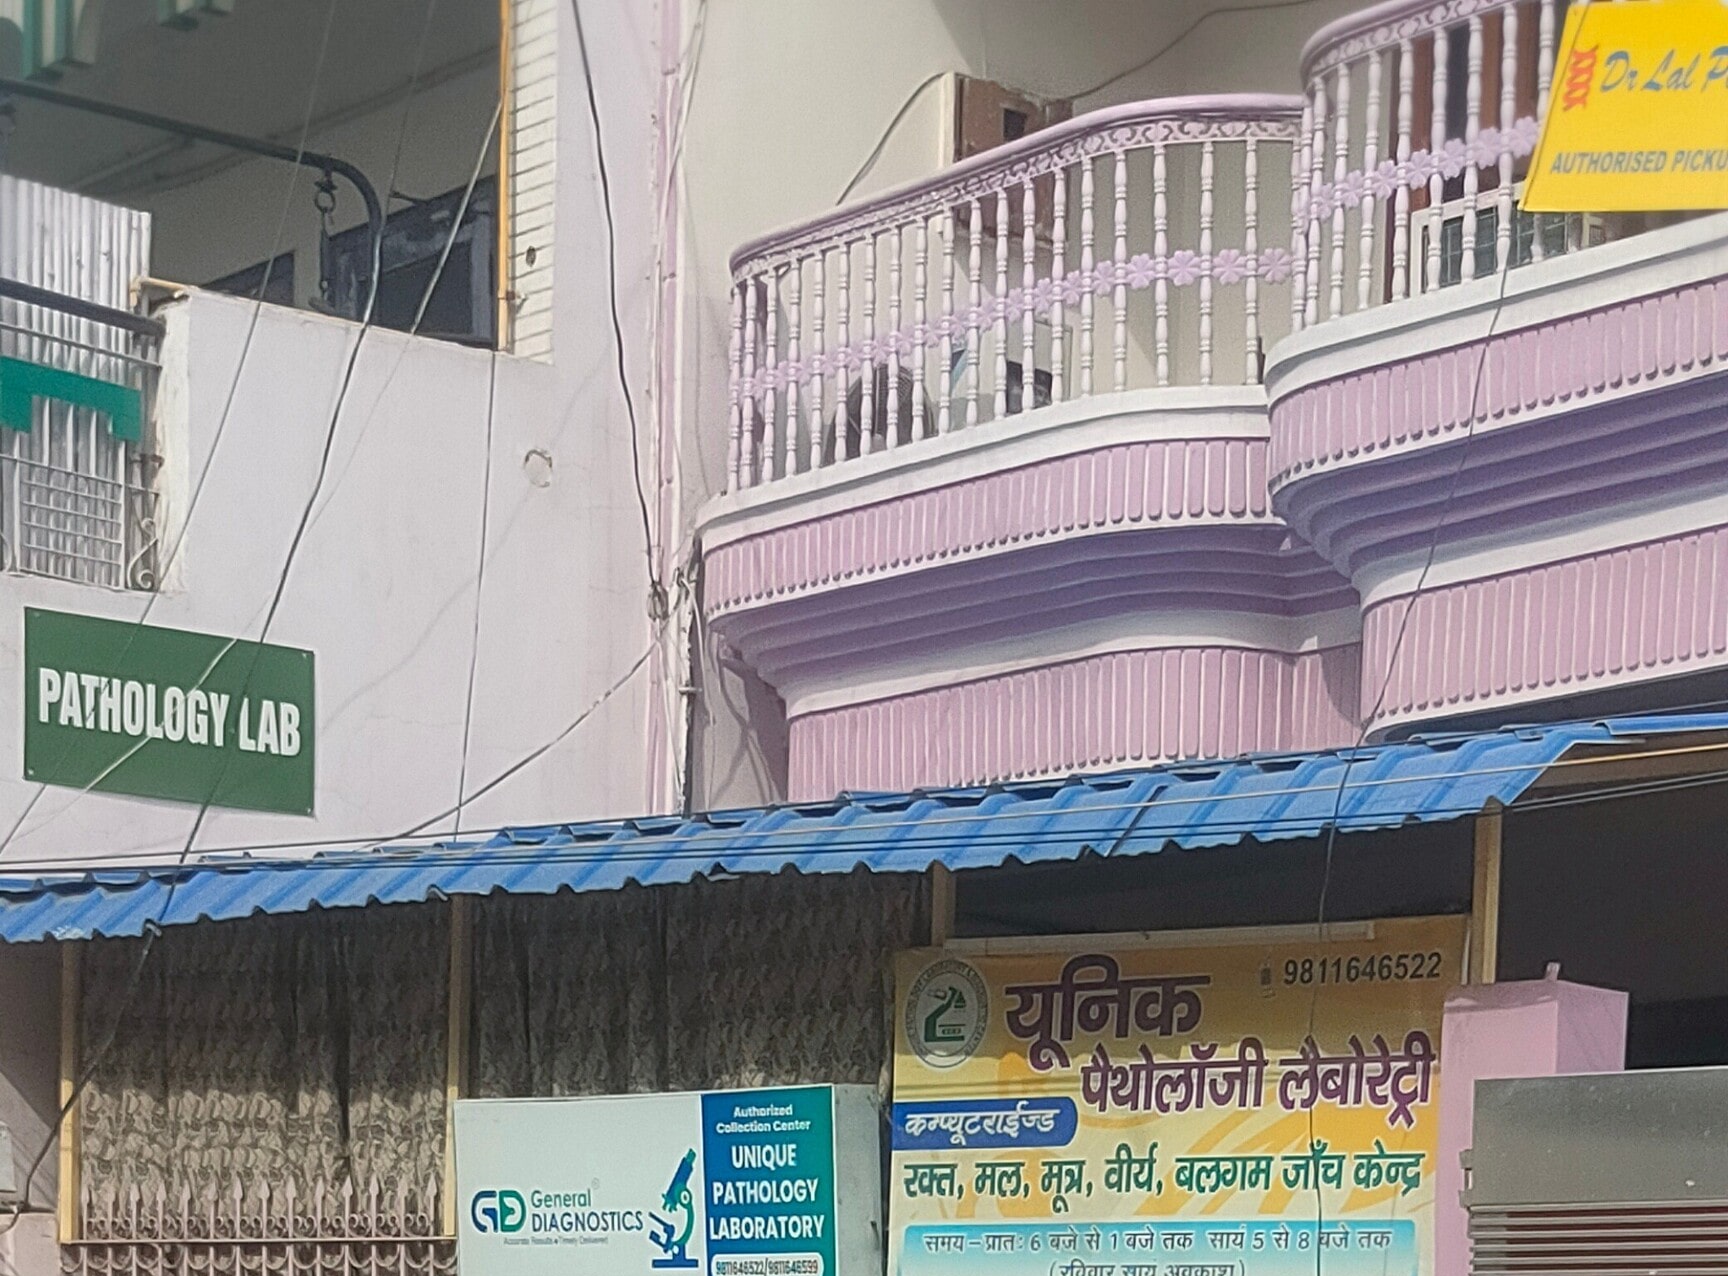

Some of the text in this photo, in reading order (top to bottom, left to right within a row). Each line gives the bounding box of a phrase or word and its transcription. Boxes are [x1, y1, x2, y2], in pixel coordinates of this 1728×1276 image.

[1600, 50, 1639, 92] Dr
[1640, 48, 1701, 92] Lal
[1551, 150, 1668, 174] AUTHORISED
[38, 667, 301, 757] PATHOLOGY LAB
[1283, 951, 1443, 986] 9811646522
[1005, 953, 1211, 1070] यूनिक
[1080, 1030, 1437, 1129] पैथोलॉजी लैबोरेट्री
[733, 1103, 794, 1118] Authorized
[904, 1100, 1061, 1146] कम्प्यूटराईज्ड
[715, 1119, 811, 1134] Collection Center
[731, 1143, 798, 1171] UNIQUE
[903, 1162, 964, 1200] रक्त,
[974, 1161, 1030, 1199] मल,
[1040, 1159, 1094, 1213] मूत्र,
[1103, 1142, 1164, 1197] वीर्य,
[1174, 1155, 1275, 1194] बलगम
[1352, 1138, 1426, 1197] केन्द्र
[530, 1188, 592, 1209] General
[712, 1177, 819, 1205] PATHOLOGY
[531, 1210, 644, 1233] DIAGNOSTICS
[709, 1214, 825, 1241] LABORATORY
[1030, 1234, 1042, 1251] 6
[1048, 1226, 1079, 1251] बजे
[1085, 1227, 1101, 1250] से
[1110, 1233, 1118, 1250] 1
[1125, 1226, 1155, 1250] बजे
[1160, 1231, 1194, 1250] तक
[1252, 1231, 1265, 1250] 5
[1272, 1225, 1289, 1249] से
[1298, 1232, 1310, 1250] 8
[1357, 1230, 1393, 1249] तक
